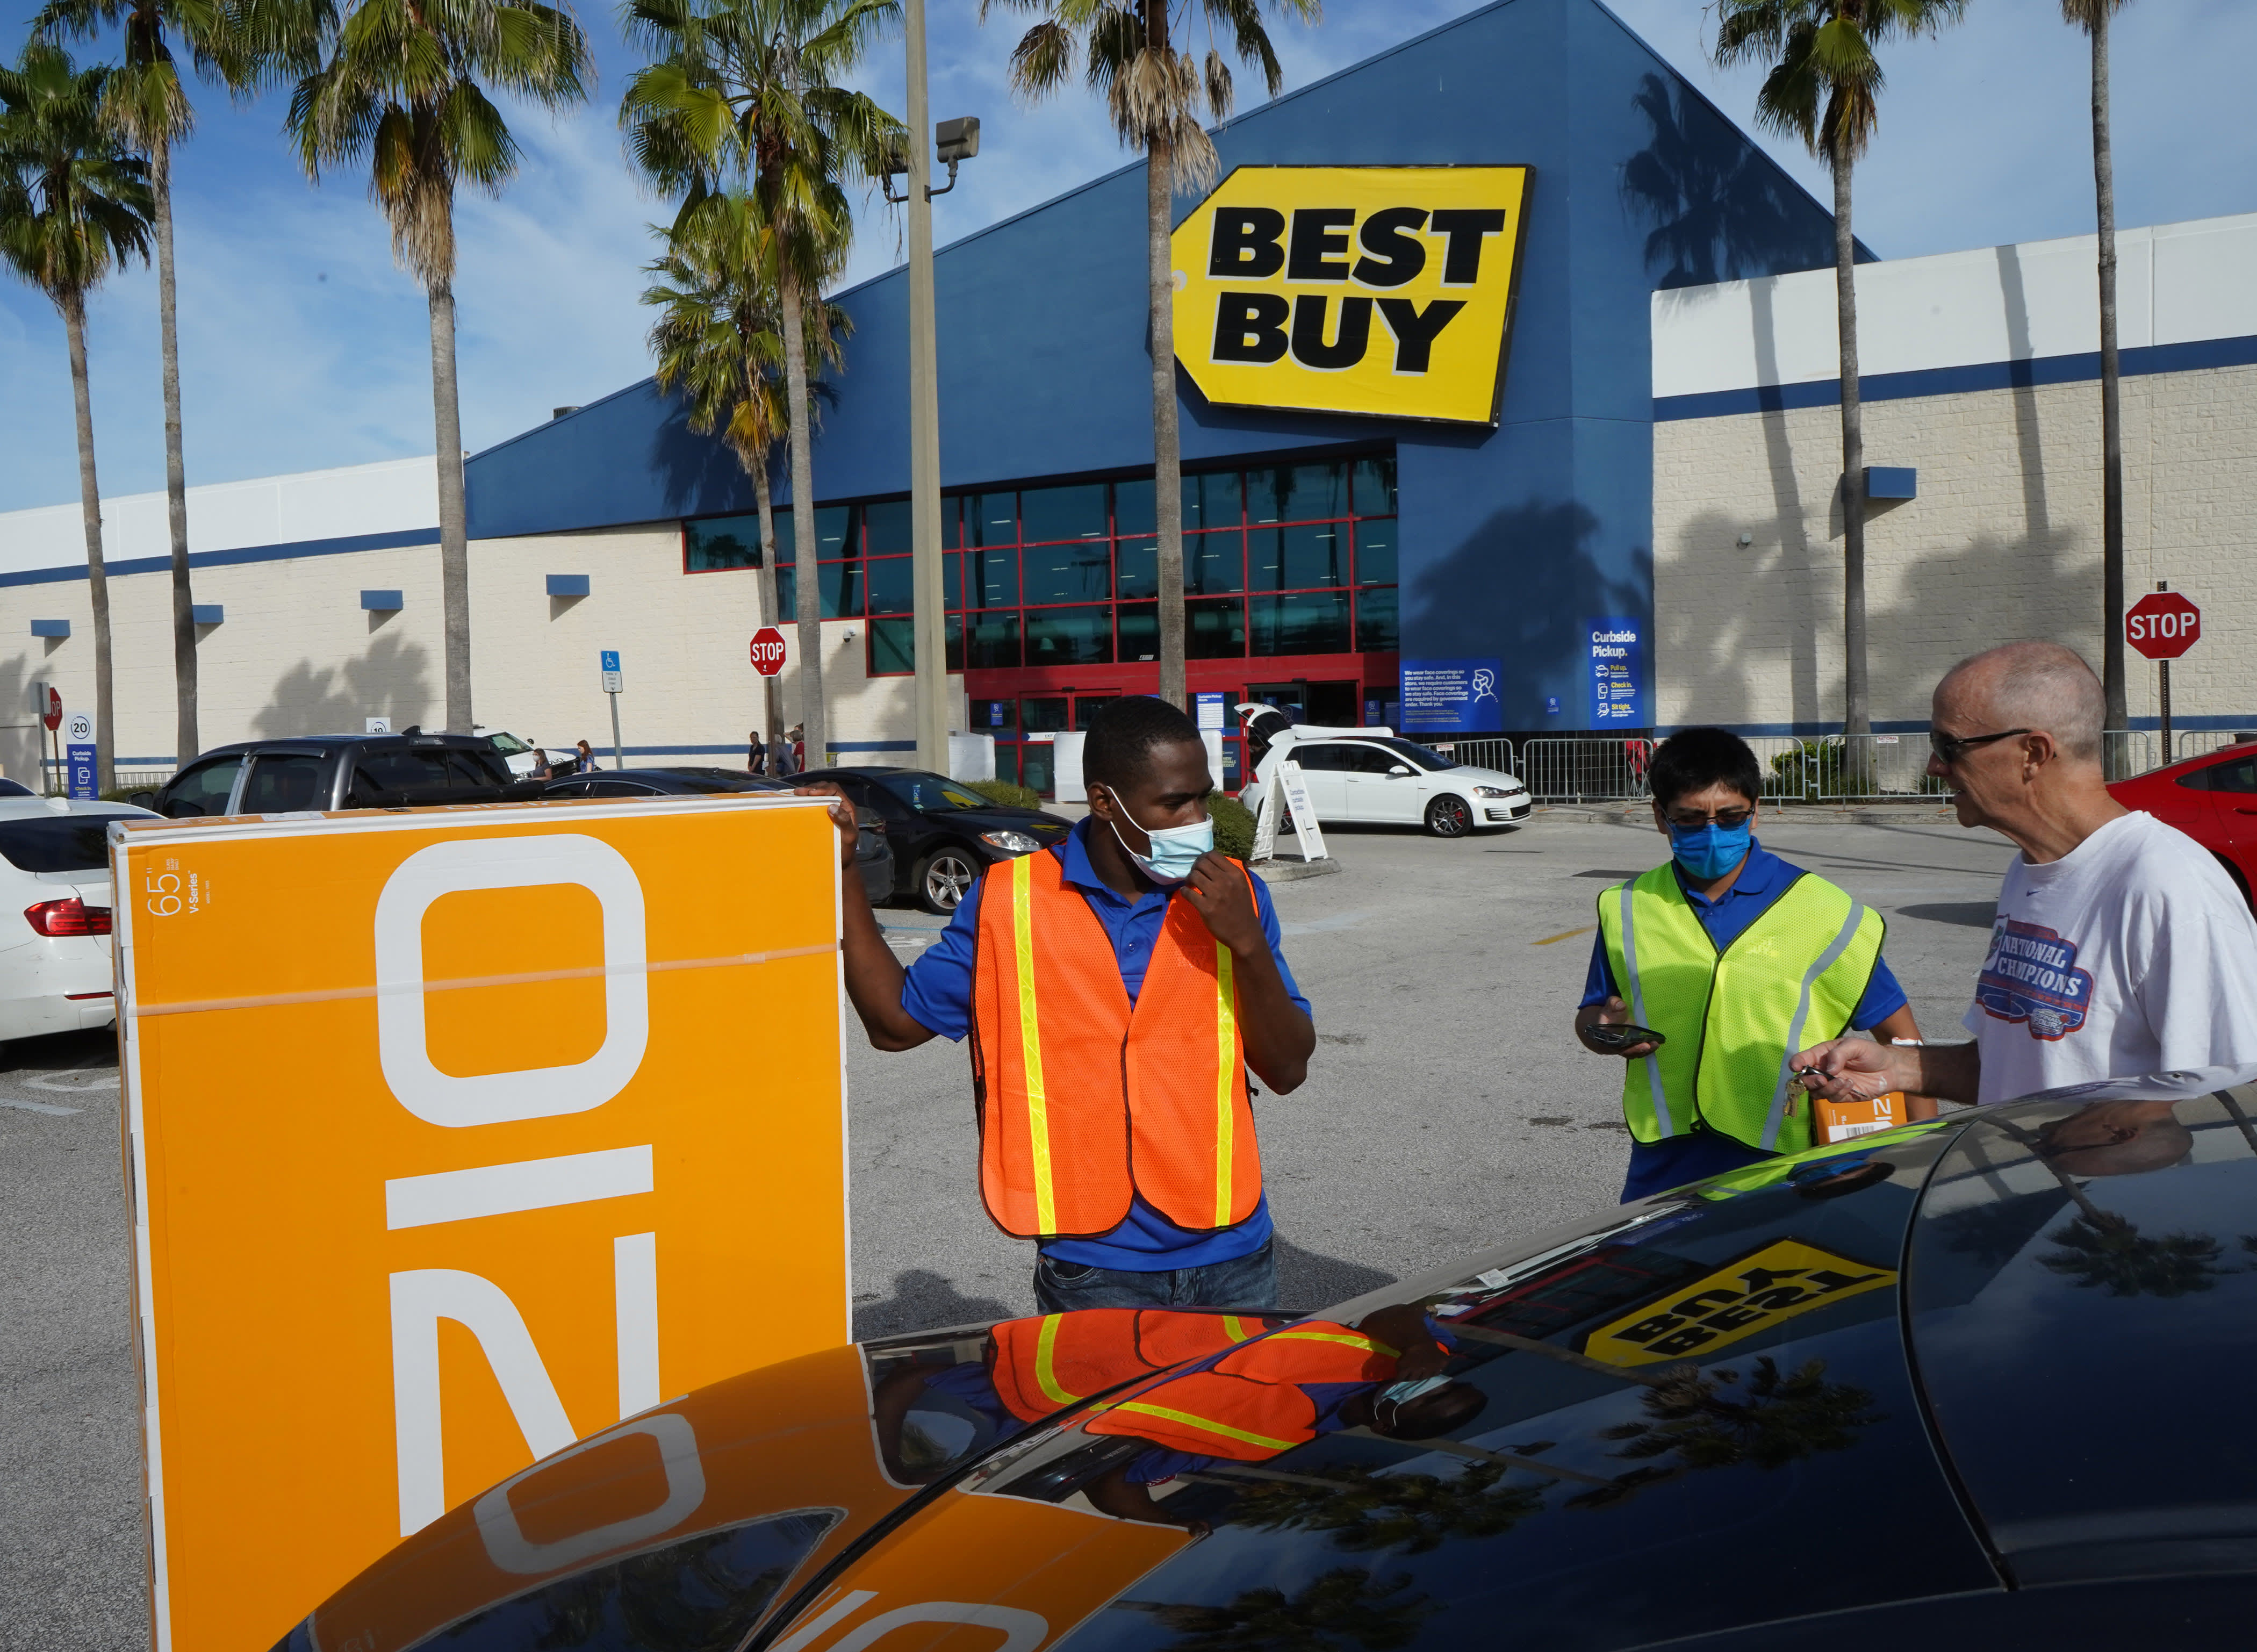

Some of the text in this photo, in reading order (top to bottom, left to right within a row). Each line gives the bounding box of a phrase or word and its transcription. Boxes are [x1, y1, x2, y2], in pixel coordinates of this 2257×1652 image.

[1206, 207, 1506, 290] BEST
[1209, 292, 1468, 376] BUY
[1592, 631, 1636, 643] Curbside
[2130, 612, 2196, 640] STOP
[752, 643, 784, 662] STOP
[1593, 645, 1628, 659] Pickup.
[74, 723, 87, 732] 20
[2001, 935, 2067, 969] NATONAL
[1997, 957, 2082, 997] CHMPIONS
[375, 833, 662, 1538] ZIO
